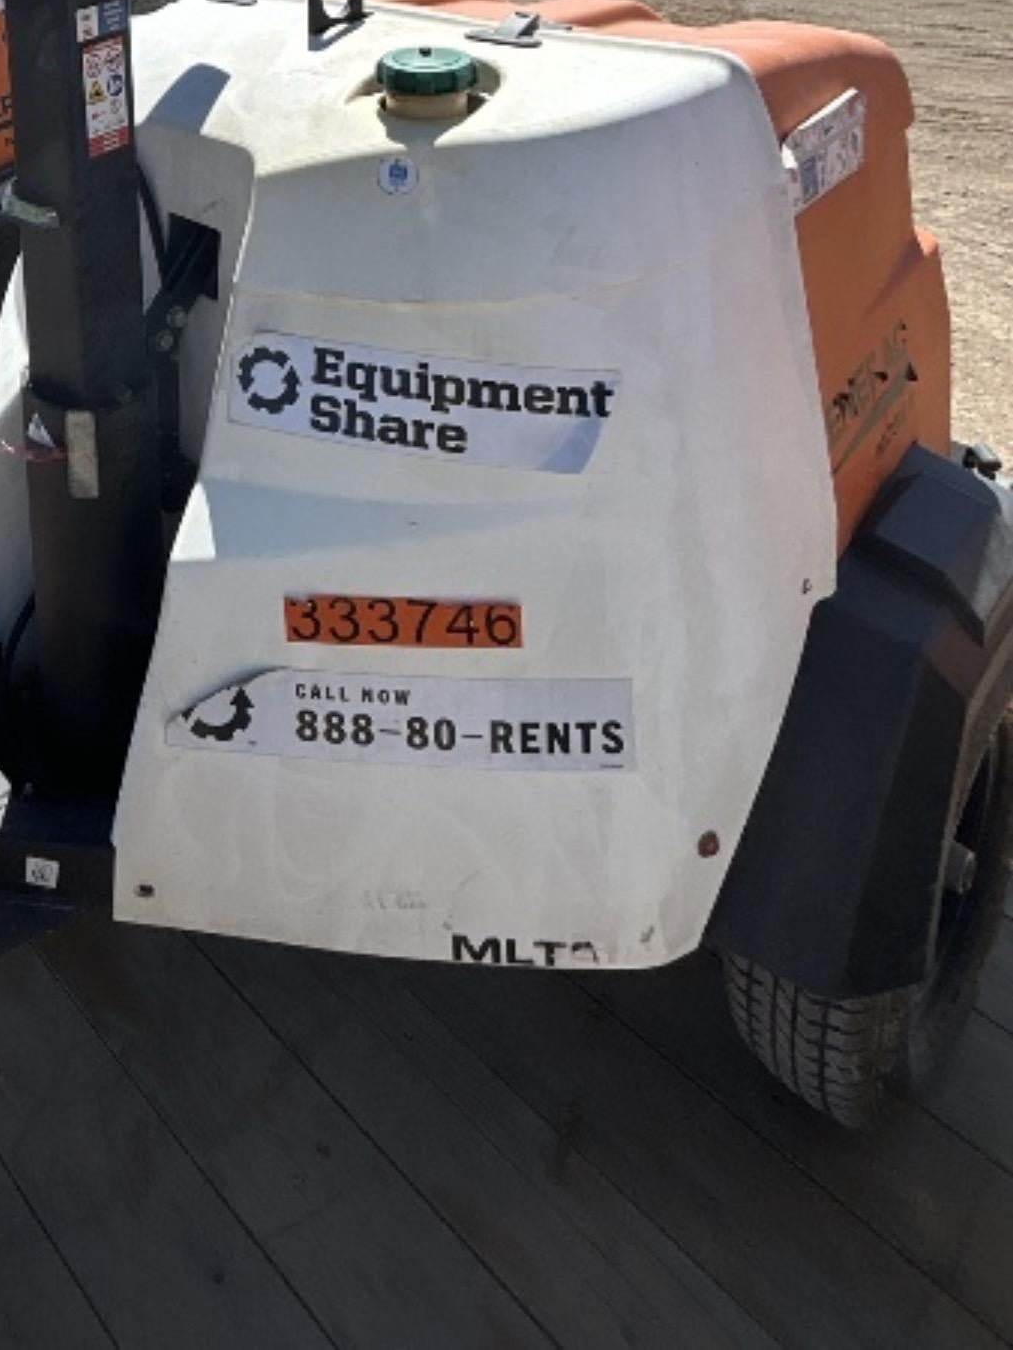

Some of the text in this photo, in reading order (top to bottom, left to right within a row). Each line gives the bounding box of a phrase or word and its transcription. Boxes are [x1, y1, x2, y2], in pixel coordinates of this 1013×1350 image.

[311, 346, 615, 418] Equipment
[309, 393, 468, 453] Share
[292, 597, 517, 645] 333746
[295, 682, 411, 706] CALL NOW
[294, 709, 625, 755] 888-80-RENTS
